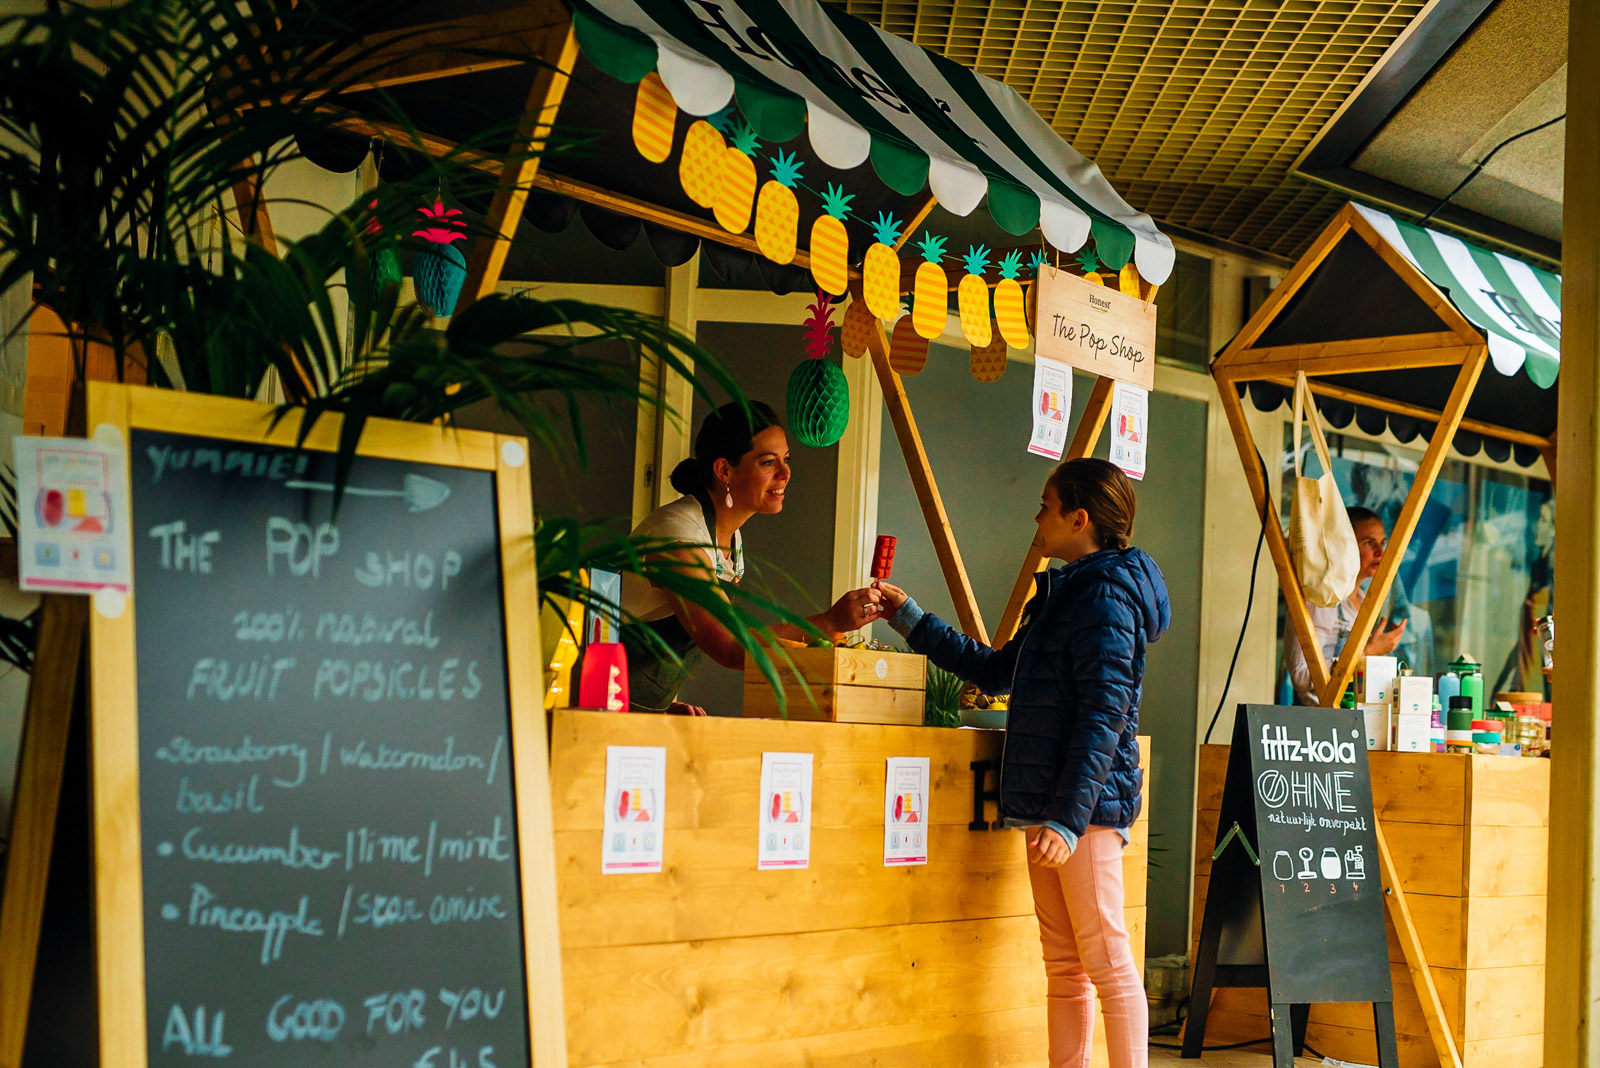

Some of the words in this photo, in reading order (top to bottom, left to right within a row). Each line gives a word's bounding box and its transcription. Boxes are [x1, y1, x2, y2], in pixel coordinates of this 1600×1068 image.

[1089, 294, 1111, 309] Honest
[1053, 313, 1076, 341] The
[1080, 323, 1108, 360] Pop
[1110, 335, 1145, 373] Shop
[149, 519, 222, 575] THE
[265, 516, 340, 579] POP
[355, 550, 462, 591] SHOP
[176, 775, 264, 814] basil
[1267, 811, 1317, 832] natuurlijk
[1319, 816, 1368, 836] onverpakt
[1280, 883, 1286, 894] 1
[1303, 882, 1311, 893] 2
[1330, 883, 1337, 895] 3
[1352, 881, 1359, 892] 4
[188, 882, 324, 965] Pineapple
[162, 1003, 233, 1057] ALL
[265, 994, 346, 1042] GOOD
[364, 987, 427, 1034] FOR
[439, 987, 506, 1030] YOU
